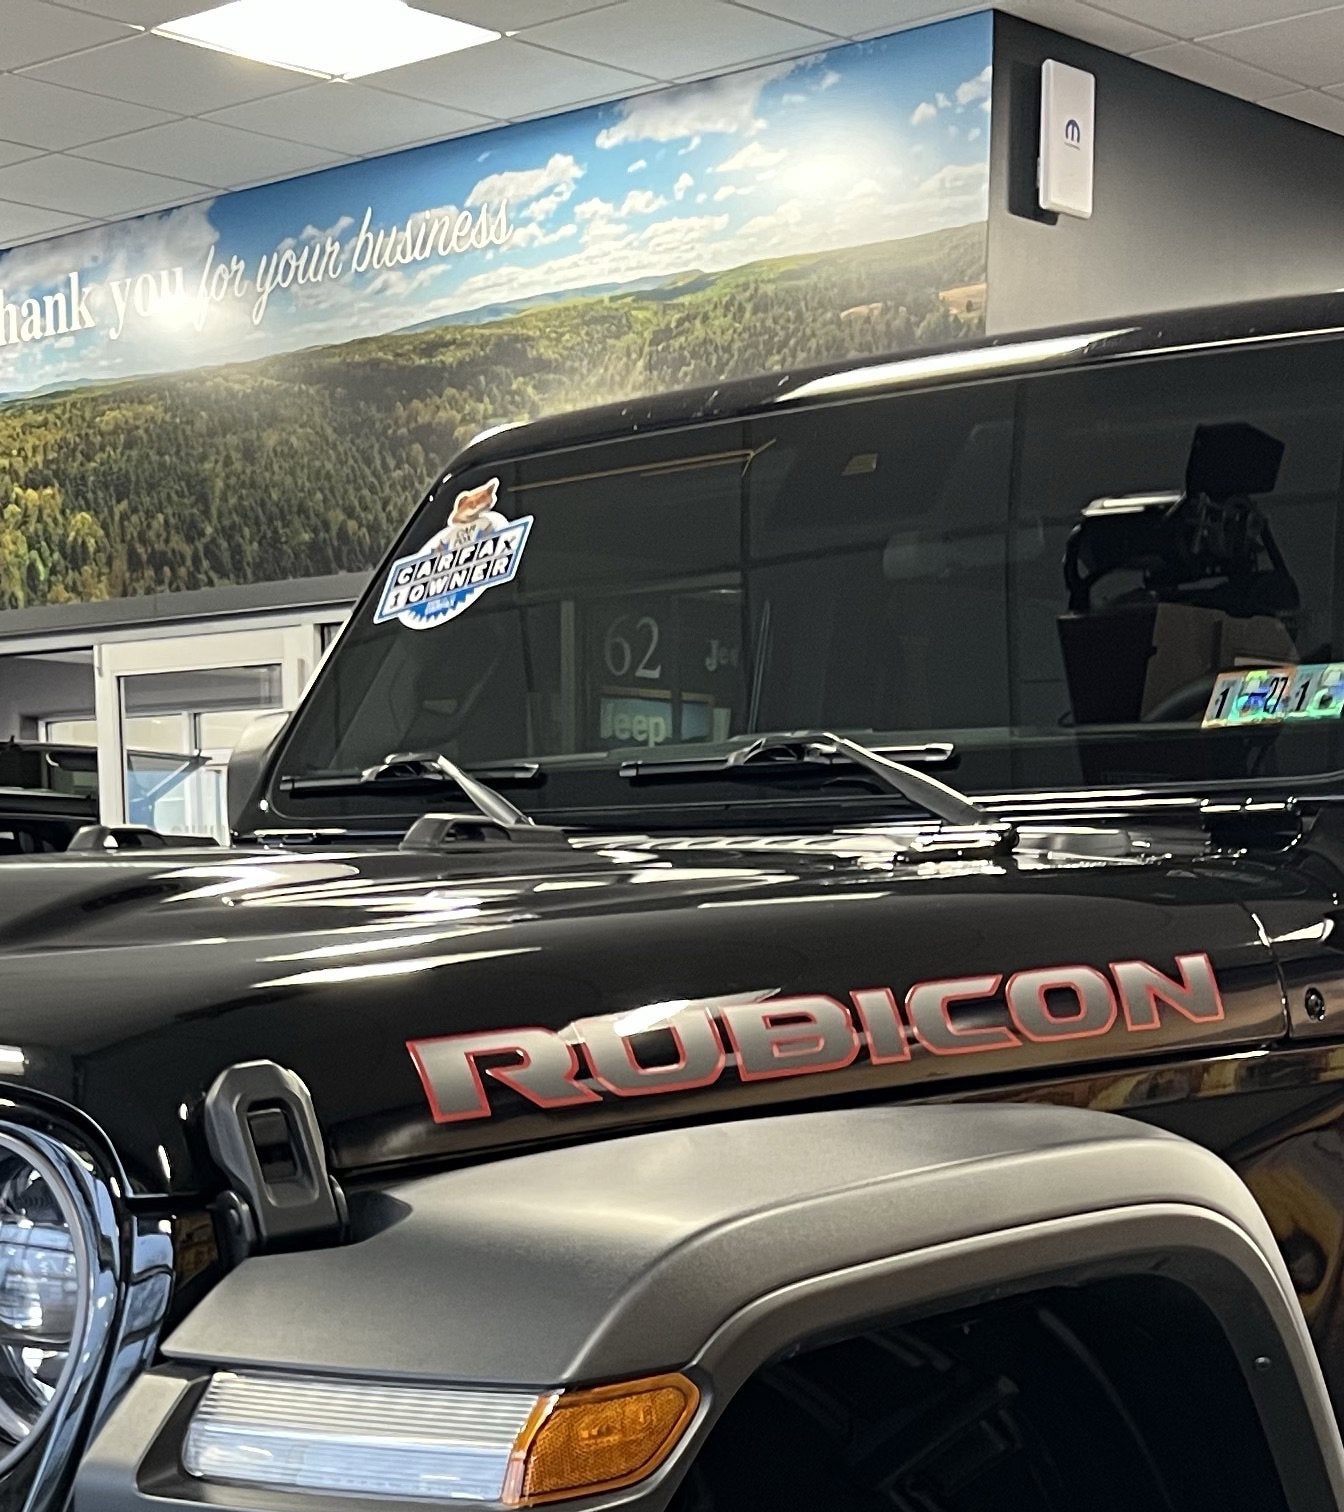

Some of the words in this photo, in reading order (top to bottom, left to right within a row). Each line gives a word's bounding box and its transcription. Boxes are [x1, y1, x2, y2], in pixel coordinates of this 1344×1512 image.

[109, 265, 187, 341] you
[194, 244, 248, 333] for
[252, 239, 344, 327] your
[352, 198, 515, 273] business
[396, 534, 518, 587] CARFAX
[405, 952, 1227, 1125] RUBICON
